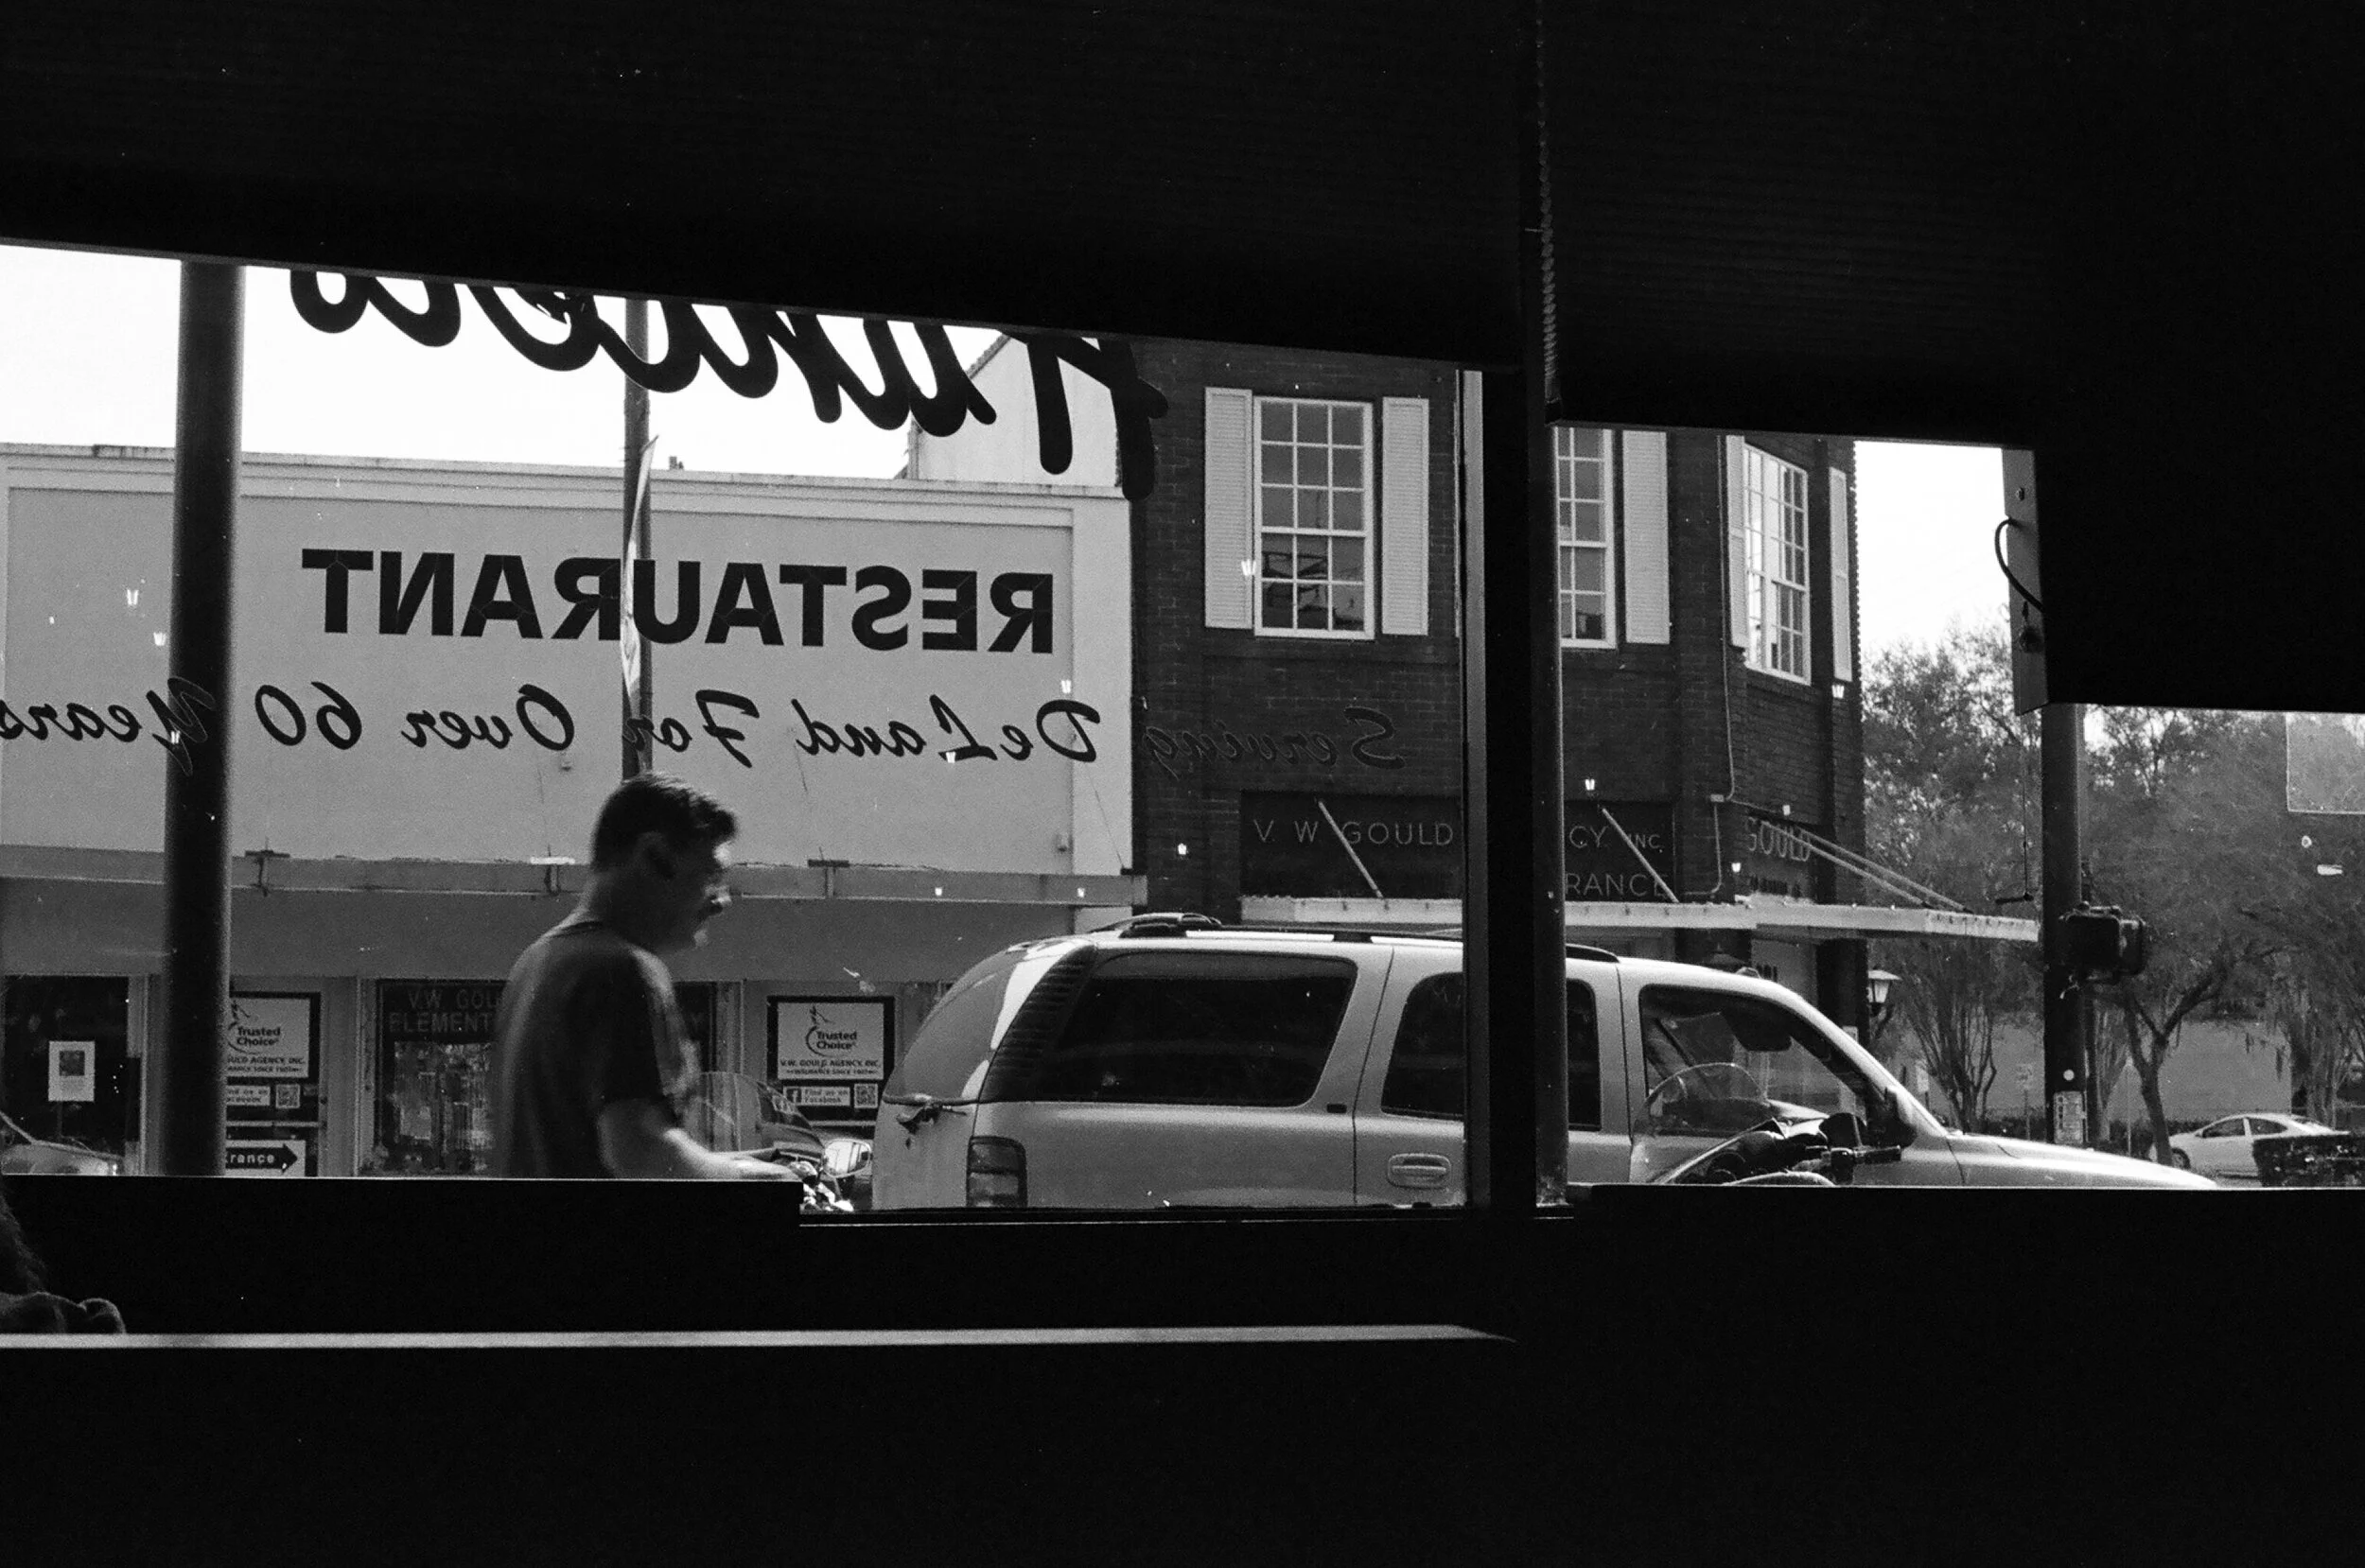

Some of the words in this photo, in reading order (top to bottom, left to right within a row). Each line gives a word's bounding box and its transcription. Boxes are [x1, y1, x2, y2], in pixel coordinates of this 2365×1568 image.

[1341, 821, 1454, 846] GOULD
[236, 1026, 281, 1037] Trusted
[816, 1031, 858, 1041] Trusted
